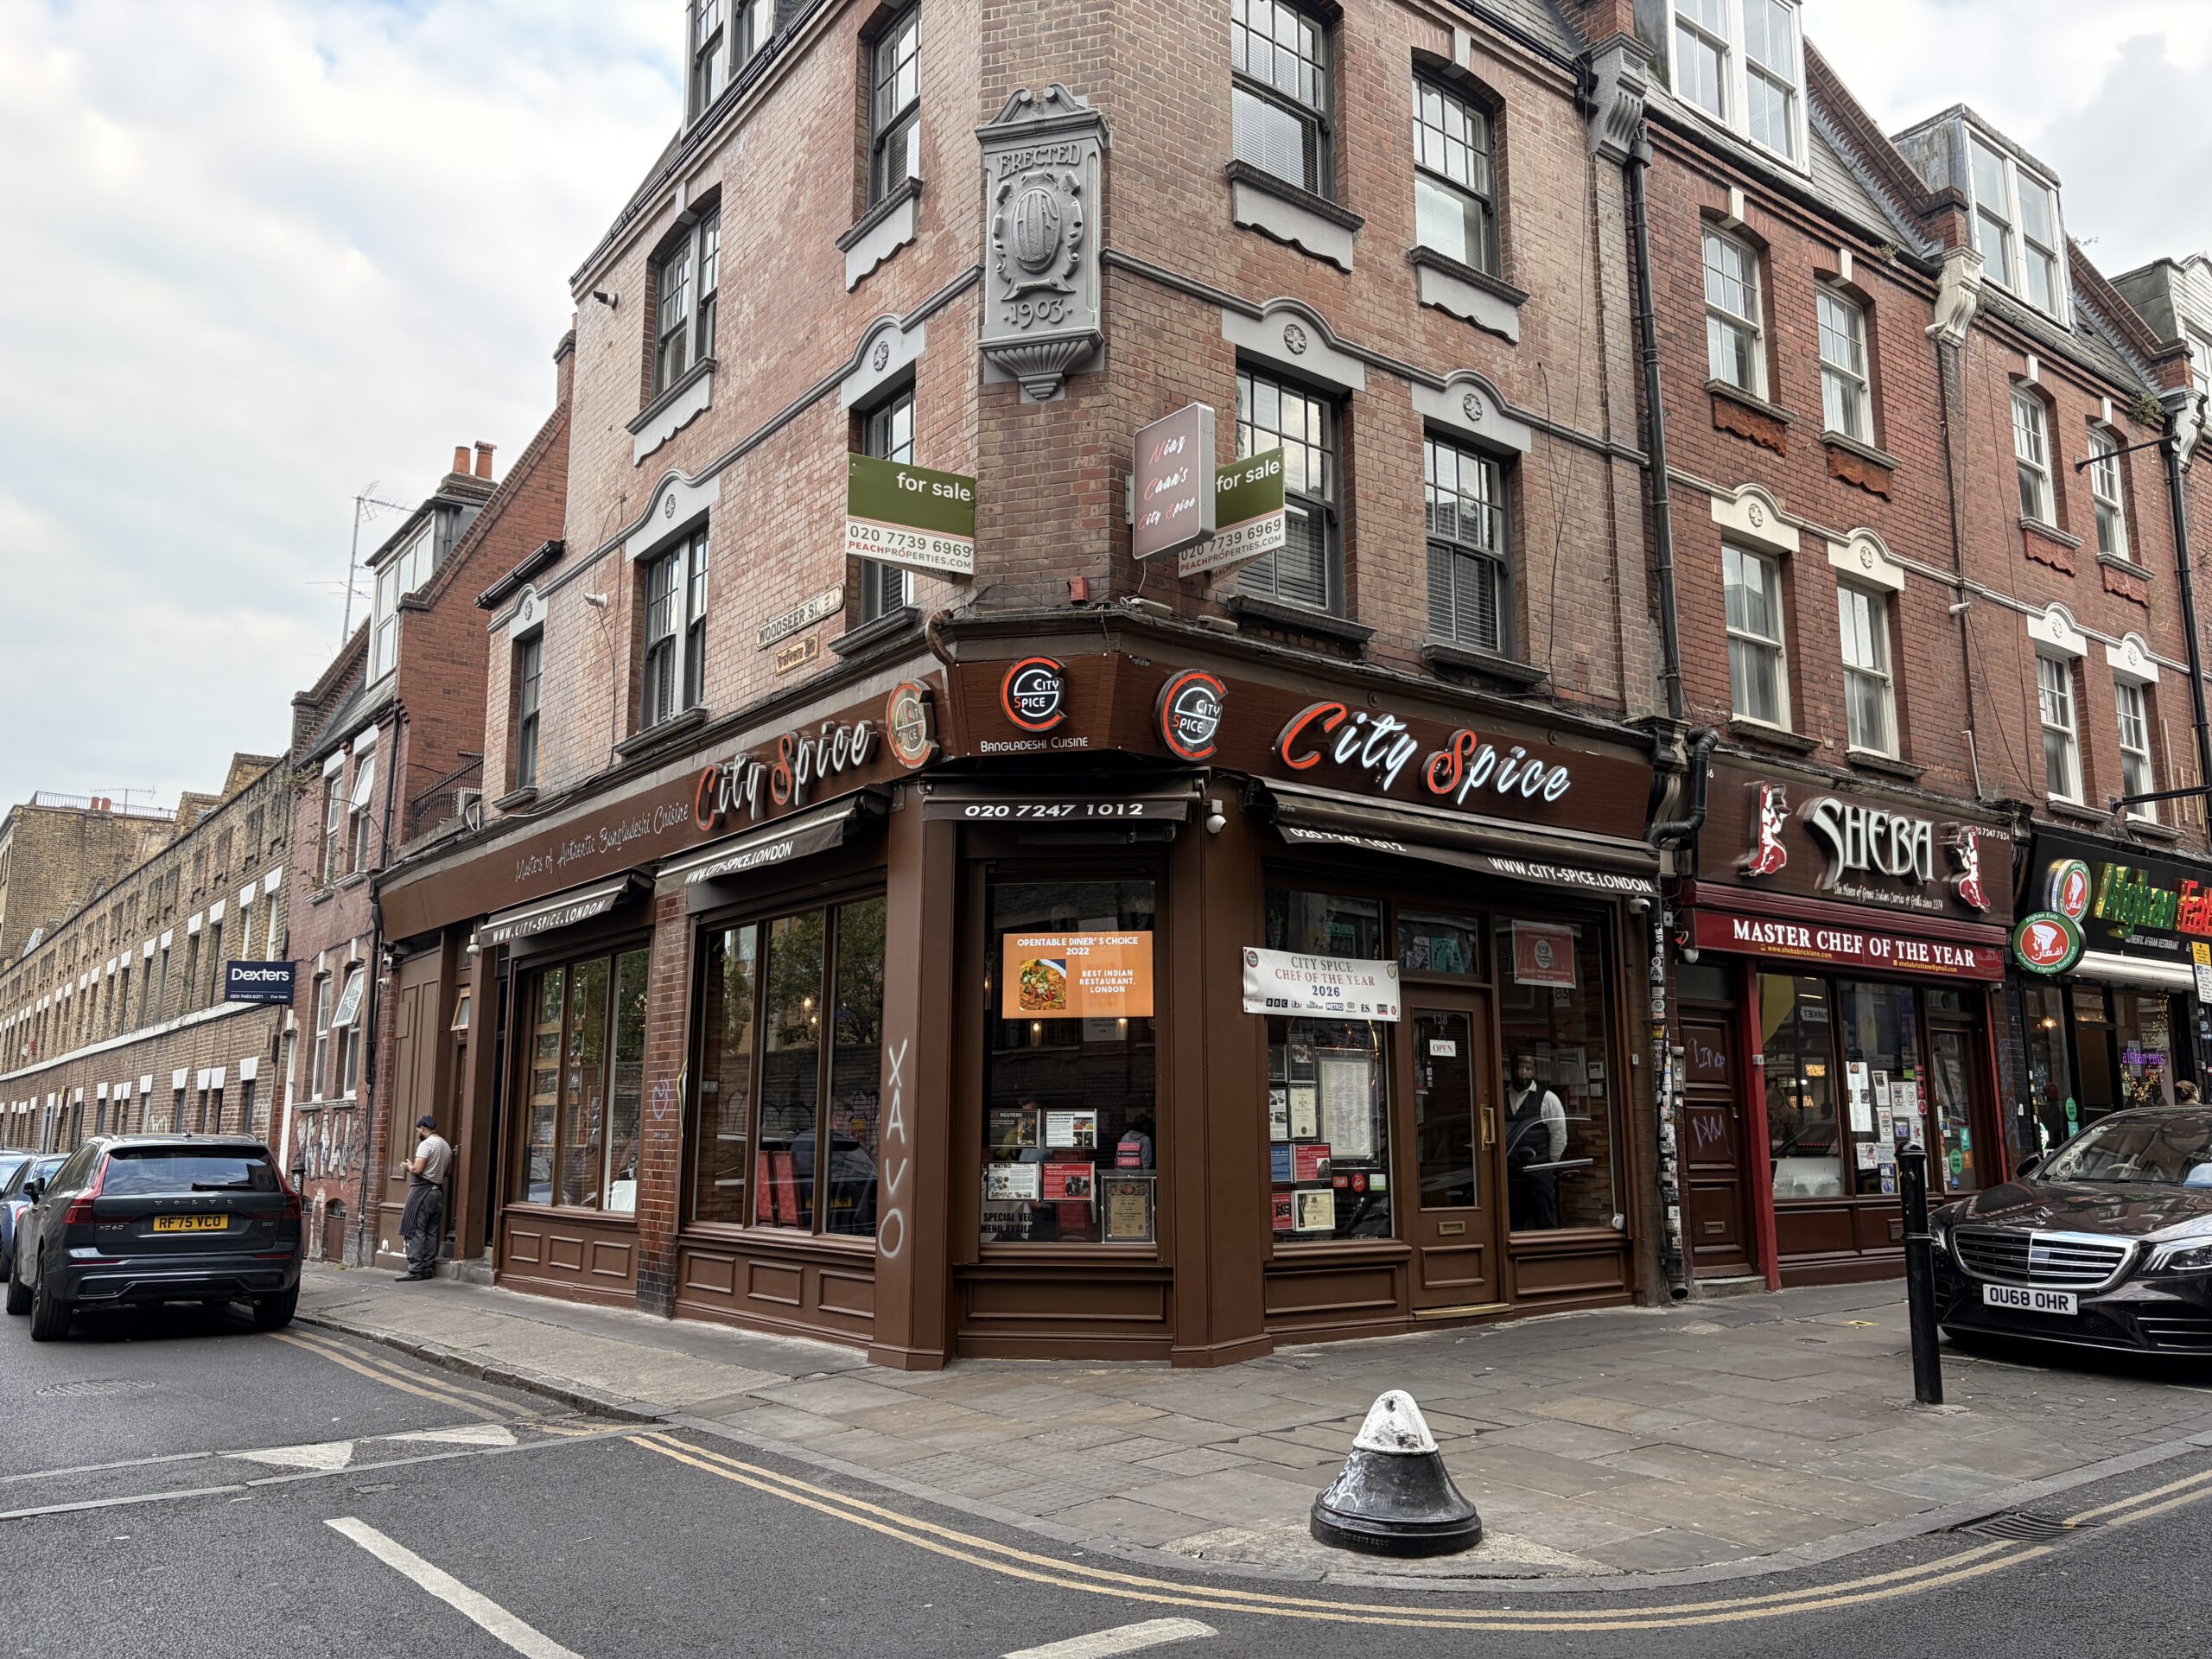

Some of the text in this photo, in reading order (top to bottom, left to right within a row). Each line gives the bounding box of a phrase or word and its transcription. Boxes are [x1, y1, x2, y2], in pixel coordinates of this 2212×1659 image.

[998, 143, 1082, 179] ERECTED
[1149, 435, 1186, 465] Niaz
[897, 473, 970, 501] for sale
[1144, 467, 1189, 500] Caan's
[1217, 460, 1280, 493] for sale
[1138, 497, 1196, 531] City Spice
[850, 525, 971, 557] 020 7739 6969
[1180, 535, 1281, 572] PEACHPROPERTIES.COM
[1181, 519, 1281, 560] 020 7739 6969
[848, 540, 971, 569] PEACHPROPERTIES.COM
[760, 608, 805, 644] WOODSEER
[1279, 701, 1571, 805] City Spice
[696, 721, 874, 830] City Spice
[965, 803, 1143, 817] 020 7247 1012
[515, 802, 689, 882] Masters of Authentic Bangladeshi Cuisine
[1291, 827, 1323, 840] 020
[1811, 796, 1937, 885] SHEBA
[684, 841, 793, 885] WWW.CITY-SPICE.LONDON
[1488, 856, 1654, 893] WWW.CITY-SPICE.LONDON
[2100, 863, 2177, 939] Afghan
[493, 899, 606, 943] WWW.CITY-SPICE.LONDON
[2025, 912, 2045, 923] Afghan
[1017, 938, 1066, 947] OPENTABLE
[1065, 947, 1090, 956] 2022
[1732, 918, 1976, 967] MASTER CHEF OF THE YEAR
[1767, 945, 1833, 958] www.shebabricklane.com
[231, 968, 289, 982] Dexters
[1275, 969, 1376, 987] CHEF OF THE YEAR
[1291, 957, 1354, 973] CITY SPICE
[1266, 997, 1288, 1008] BBC
[1312, 985, 1340, 997] 2026
[1325, 1002, 1344, 1011] METRO
[1433, 1014, 1448, 1025] 138
[1433, 1044, 1452, 1053] OPEN
[2122, 1048, 2165, 1065] afghan eats
[879, 1039, 907, 1258] XAVO
[159, 1215, 221, 1229] RF75 VCO
[981, 1224, 1002, 1233] MENU
[983, 1213, 1015, 1222] SPECIAL
[1989, 1287, 2069, 1312] OU68 OHR
